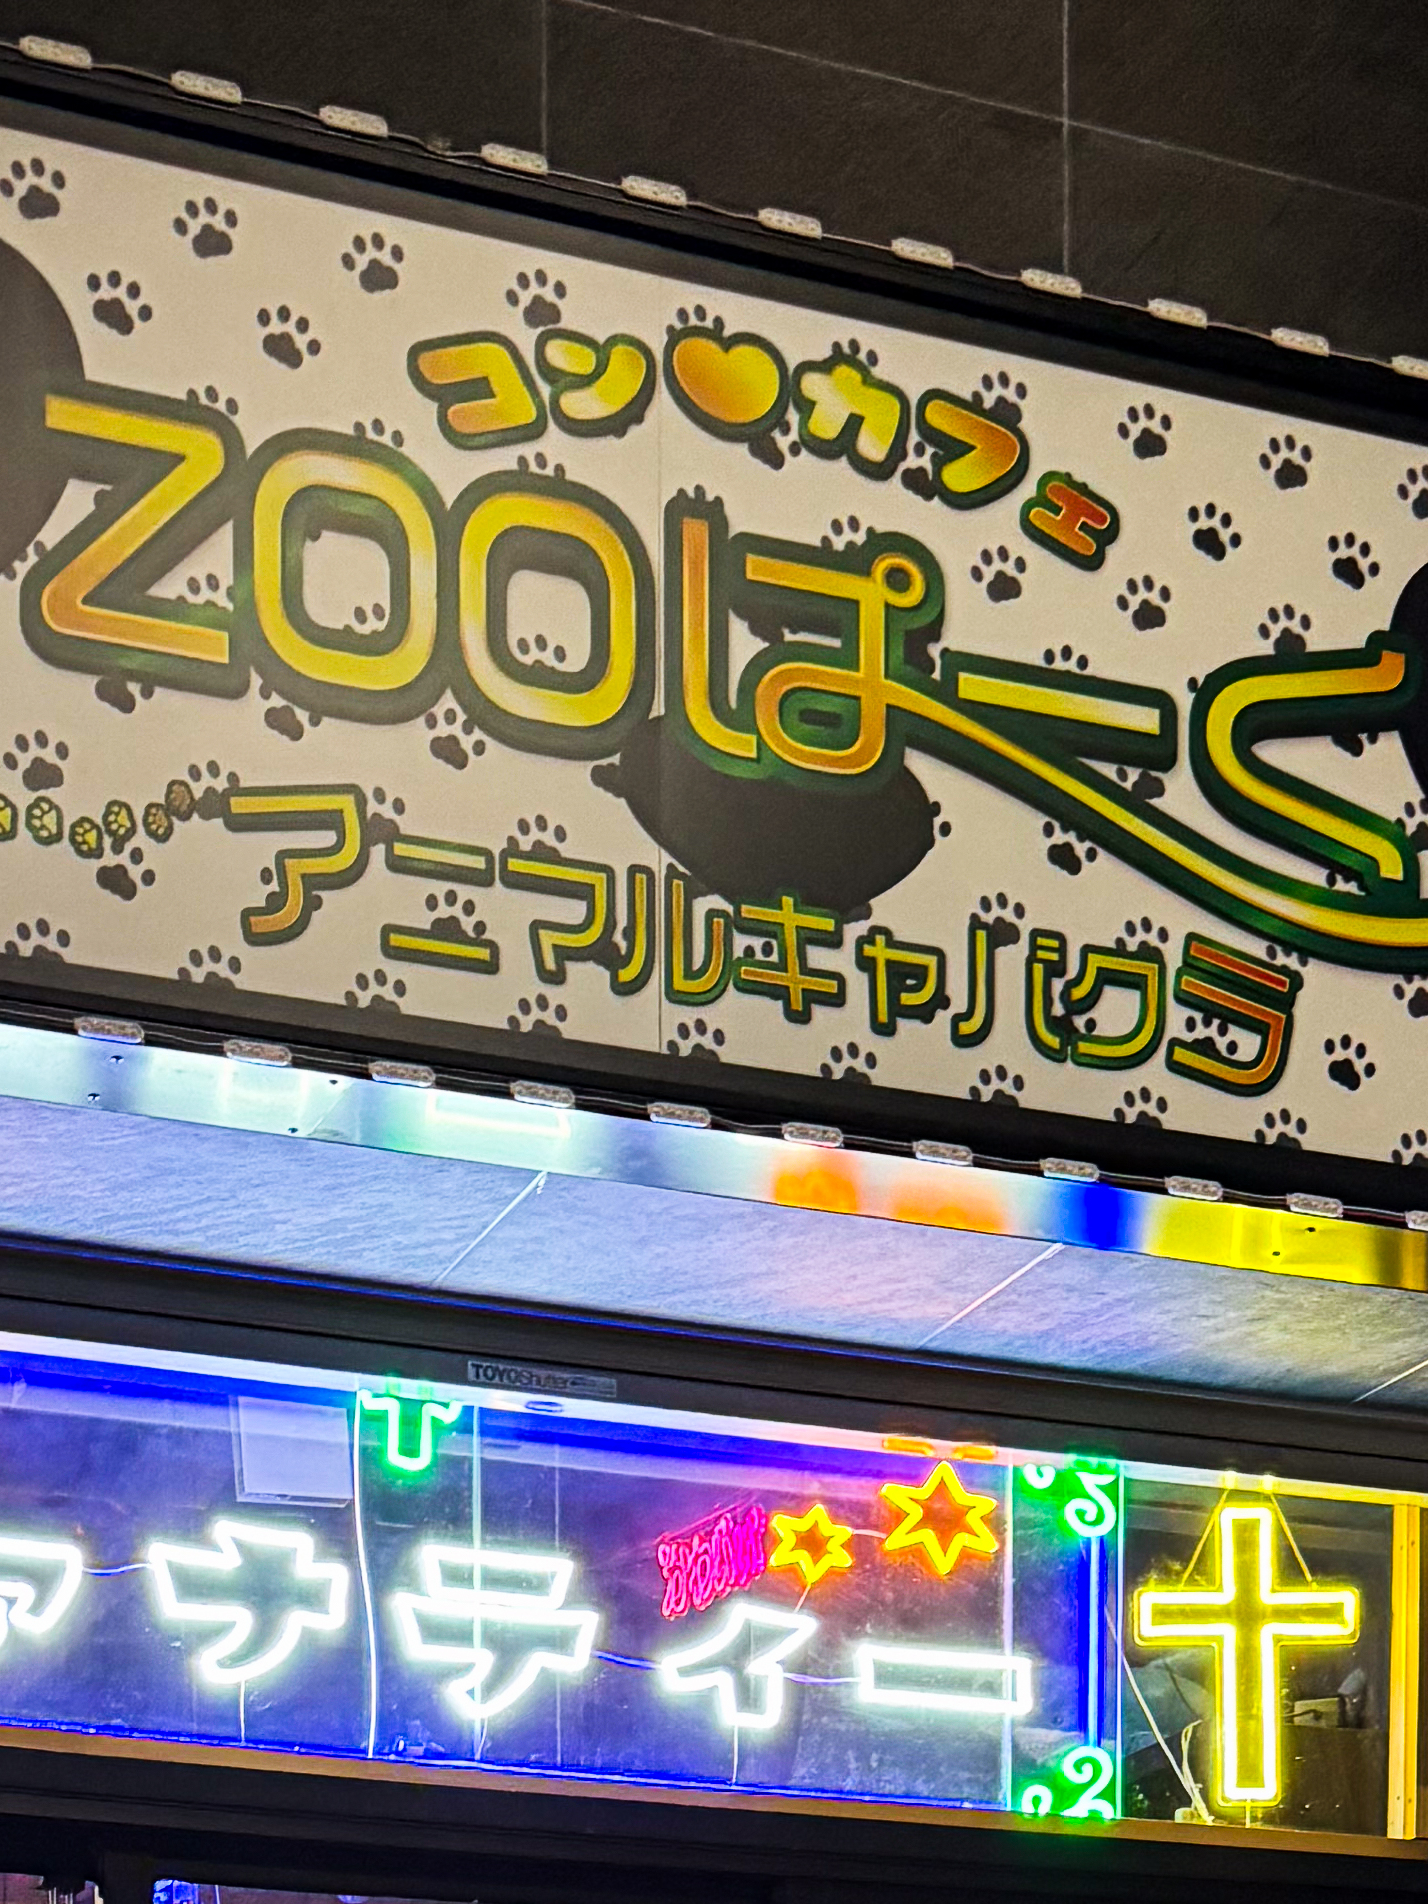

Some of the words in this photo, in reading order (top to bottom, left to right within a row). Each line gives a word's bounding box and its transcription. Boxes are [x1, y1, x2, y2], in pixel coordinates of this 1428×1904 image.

[222, 782, 1304, 1096] アニマルキャバクラ
